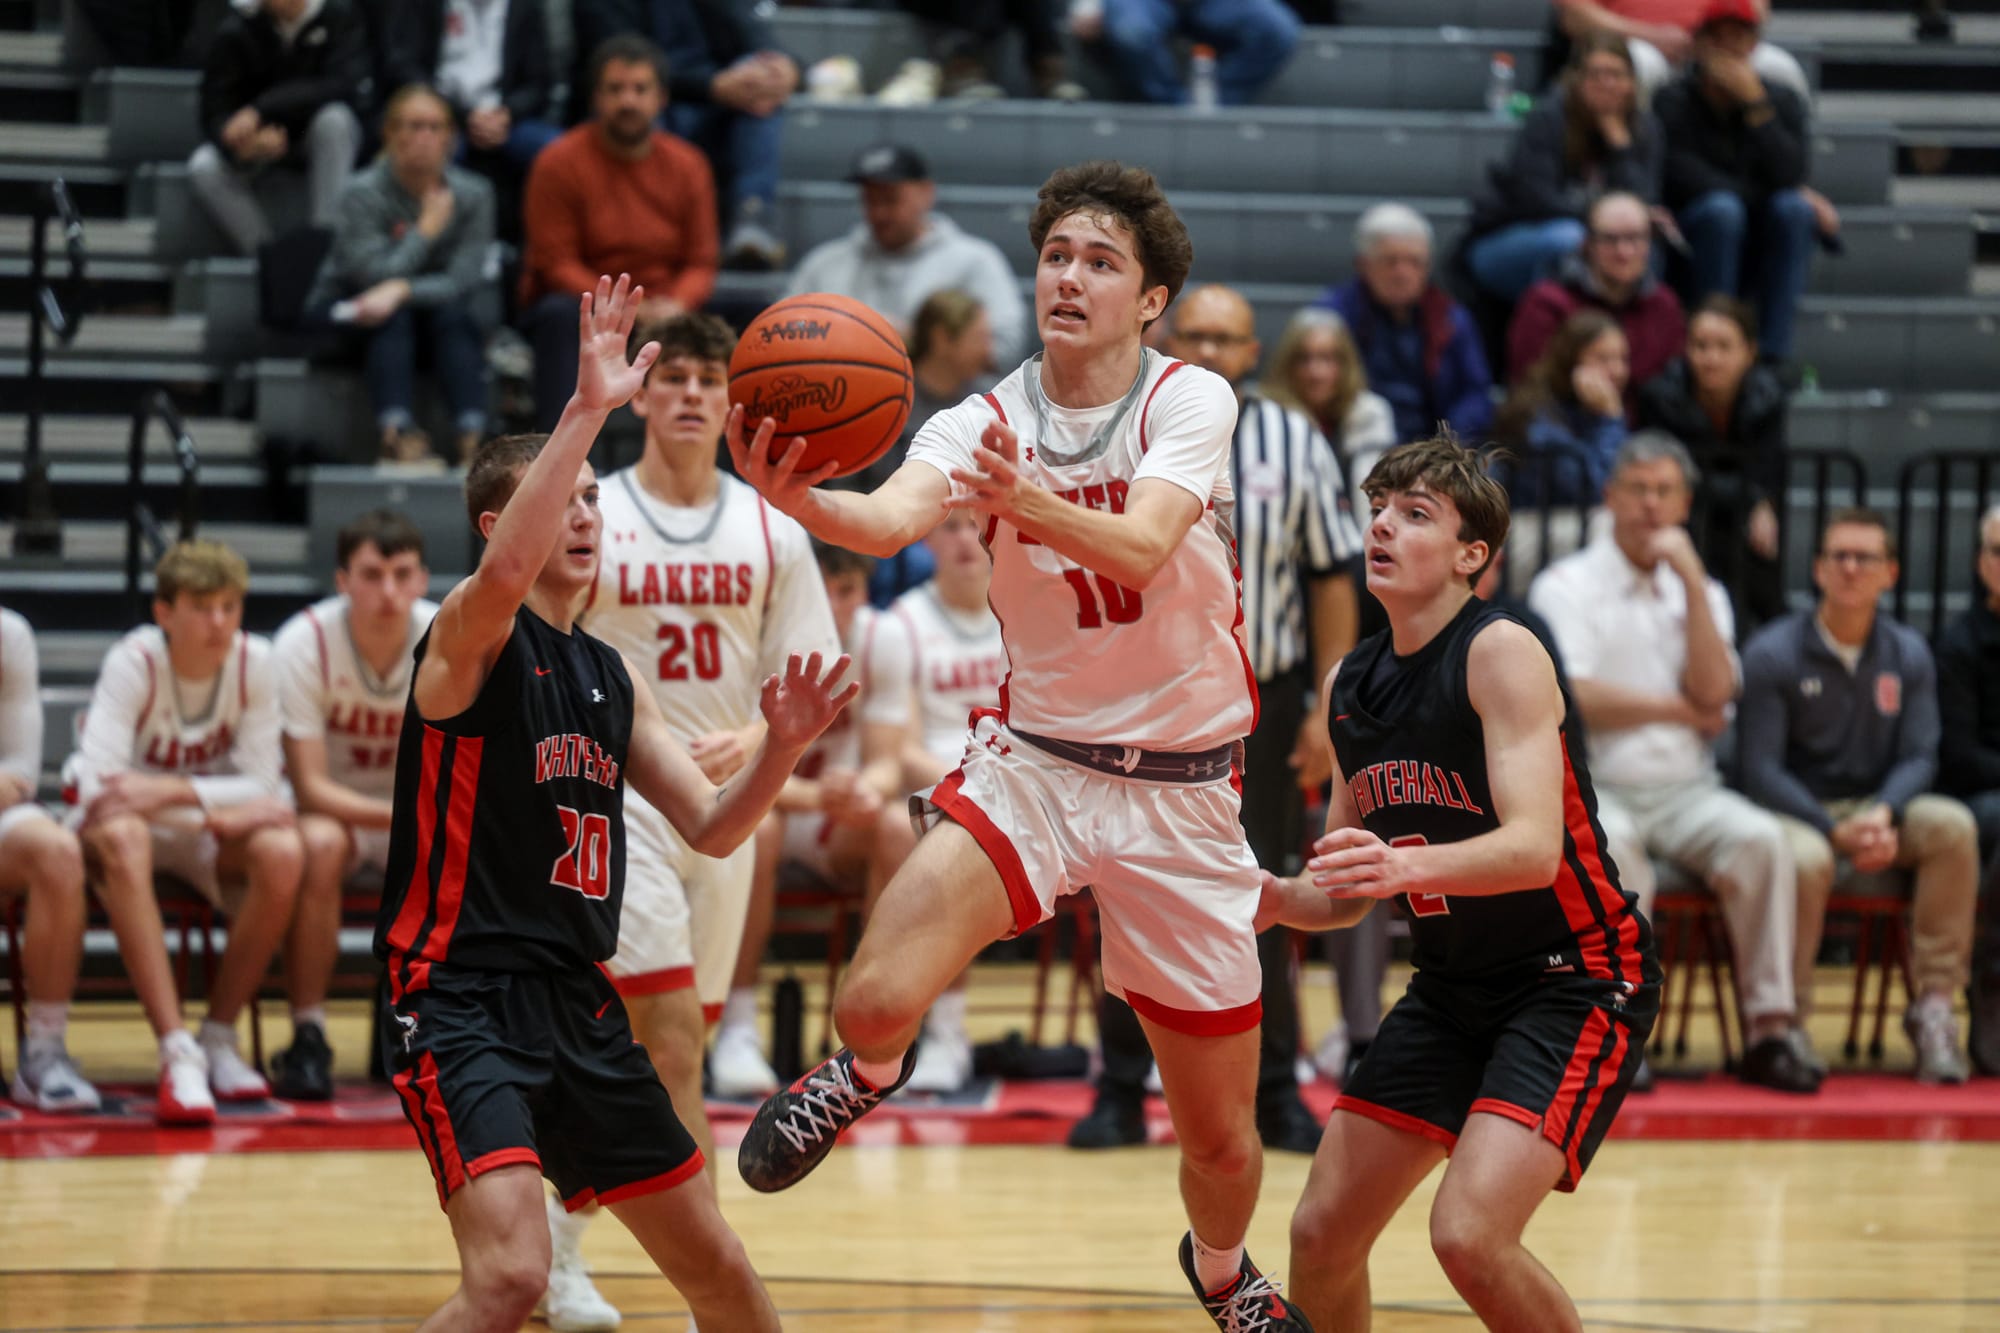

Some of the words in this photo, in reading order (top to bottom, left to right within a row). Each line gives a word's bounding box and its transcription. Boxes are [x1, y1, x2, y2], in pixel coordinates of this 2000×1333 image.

[744, 376, 847, 424] Rawlings
[618, 563, 752, 606] LAKERS
[1063, 567, 1143, 629] 10
[657, 621, 721, 681] 20
[1350, 759, 1483, 818] HITEHALL
[550, 804, 612, 900] 20
[1548, 953, 1563, 967] M
